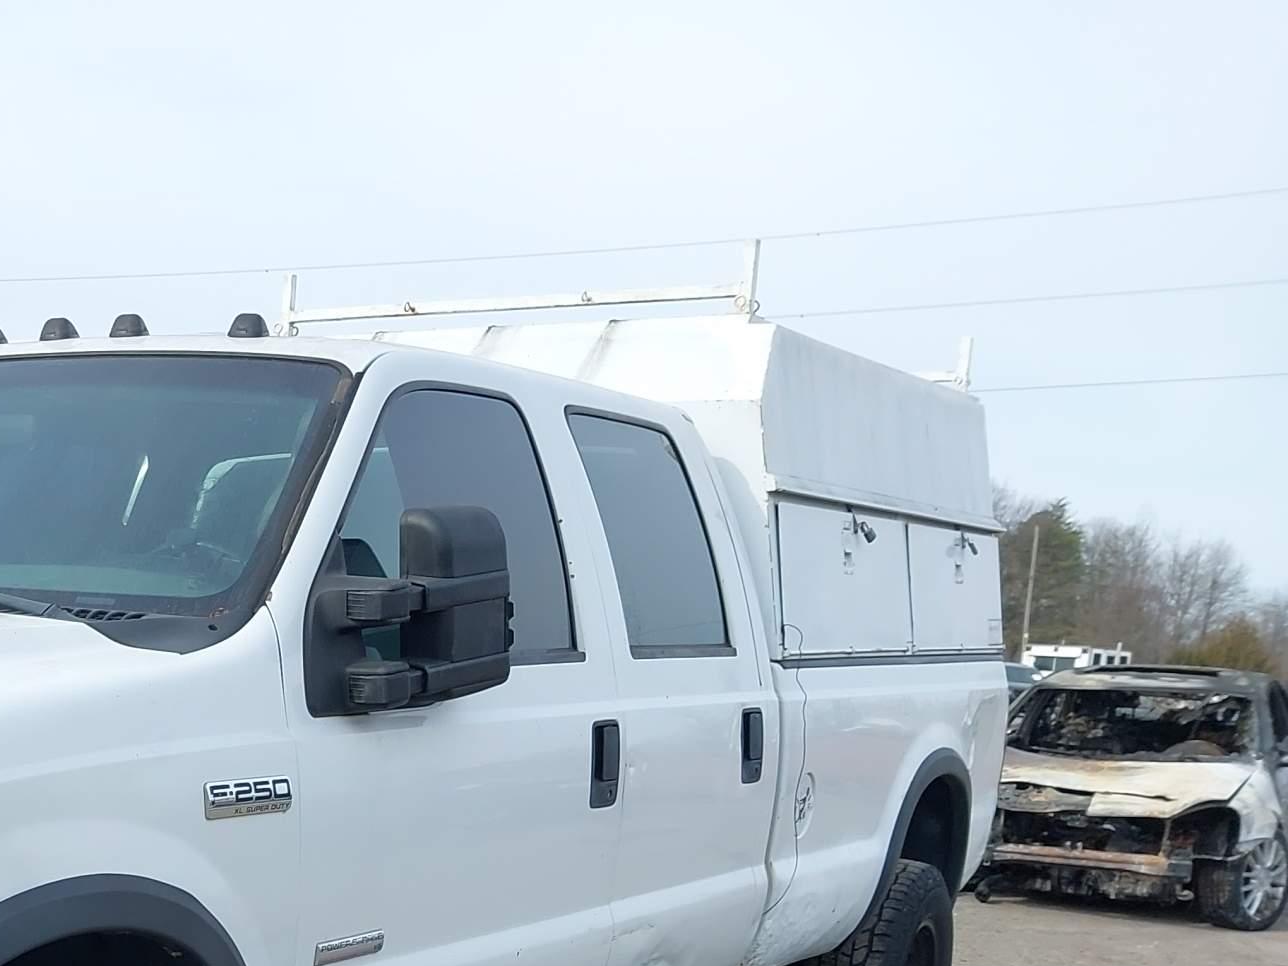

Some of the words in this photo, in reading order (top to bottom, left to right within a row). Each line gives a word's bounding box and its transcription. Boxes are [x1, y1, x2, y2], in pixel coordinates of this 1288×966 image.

[234, 805, 244, 815] XL
[246, 803, 270, 814] SUPER
[270, 801, 291, 811] DUTY
